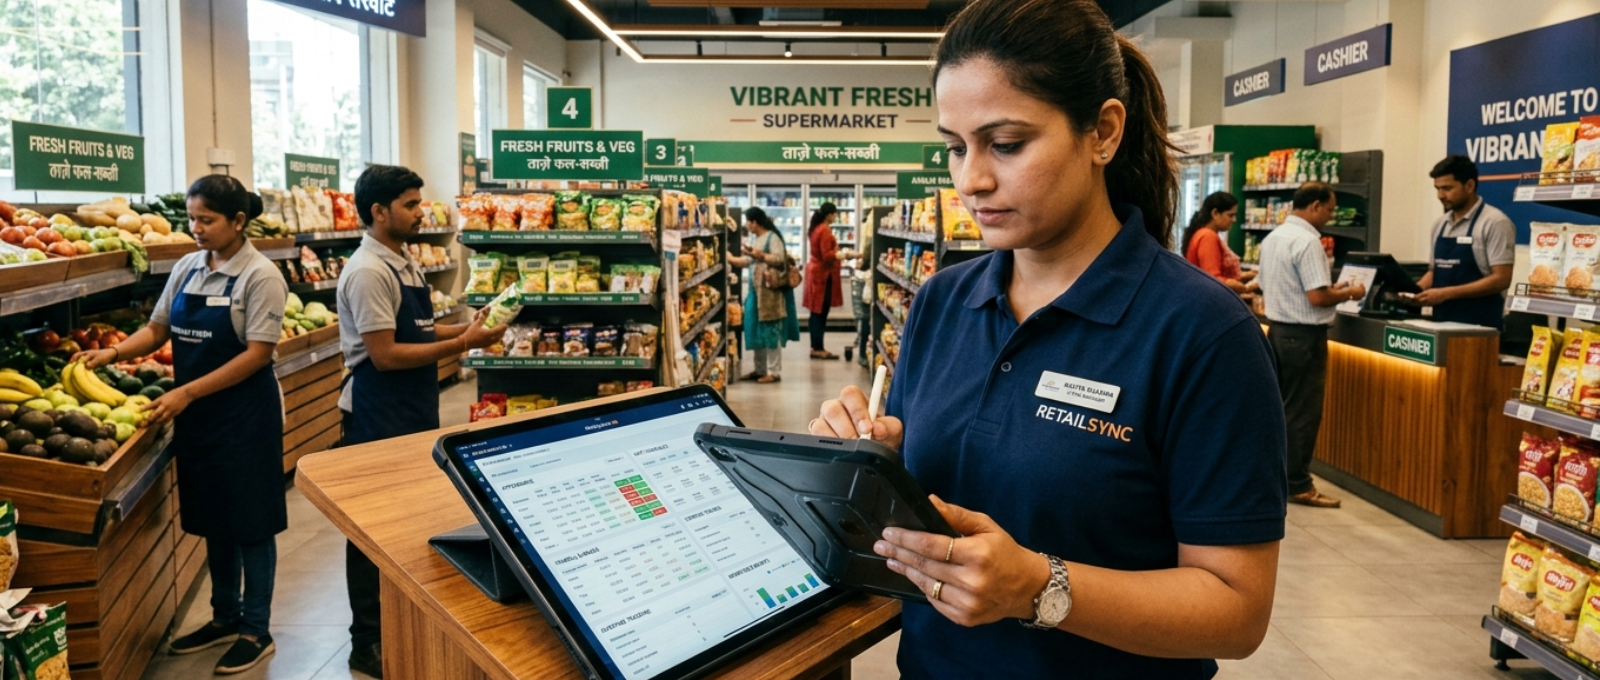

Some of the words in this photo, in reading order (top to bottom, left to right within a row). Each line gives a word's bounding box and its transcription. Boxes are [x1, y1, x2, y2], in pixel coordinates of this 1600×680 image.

[1317, 40, 1368, 73] CASHIER
[730, 86, 844, 107] VIBRANT
[851, 87, 932, 107] FRESH
[1481, 91, 1567, 126] WELCOME
[1570, 86, 1598, 114] TO
[561, 97, 578, 120] 4
[763, 113, 898, 128] SUPERMARKET
[29, 135, 66, 154] FRESH
[68, 139, 105, 157] FRUITS
[501, 140, 543, 152] FRESH
[546, 141, 593, 152] FRUITS
[596, 141, 606, 152] &
[609, 141, 635, 153] VEG
[655, 145, 667, 160] 3
[1465, 129, 1547, 163] VIBRAN
[931, 151, 942, 165] 4
[1035, 404, 1134, 442] RETAILSYNC
